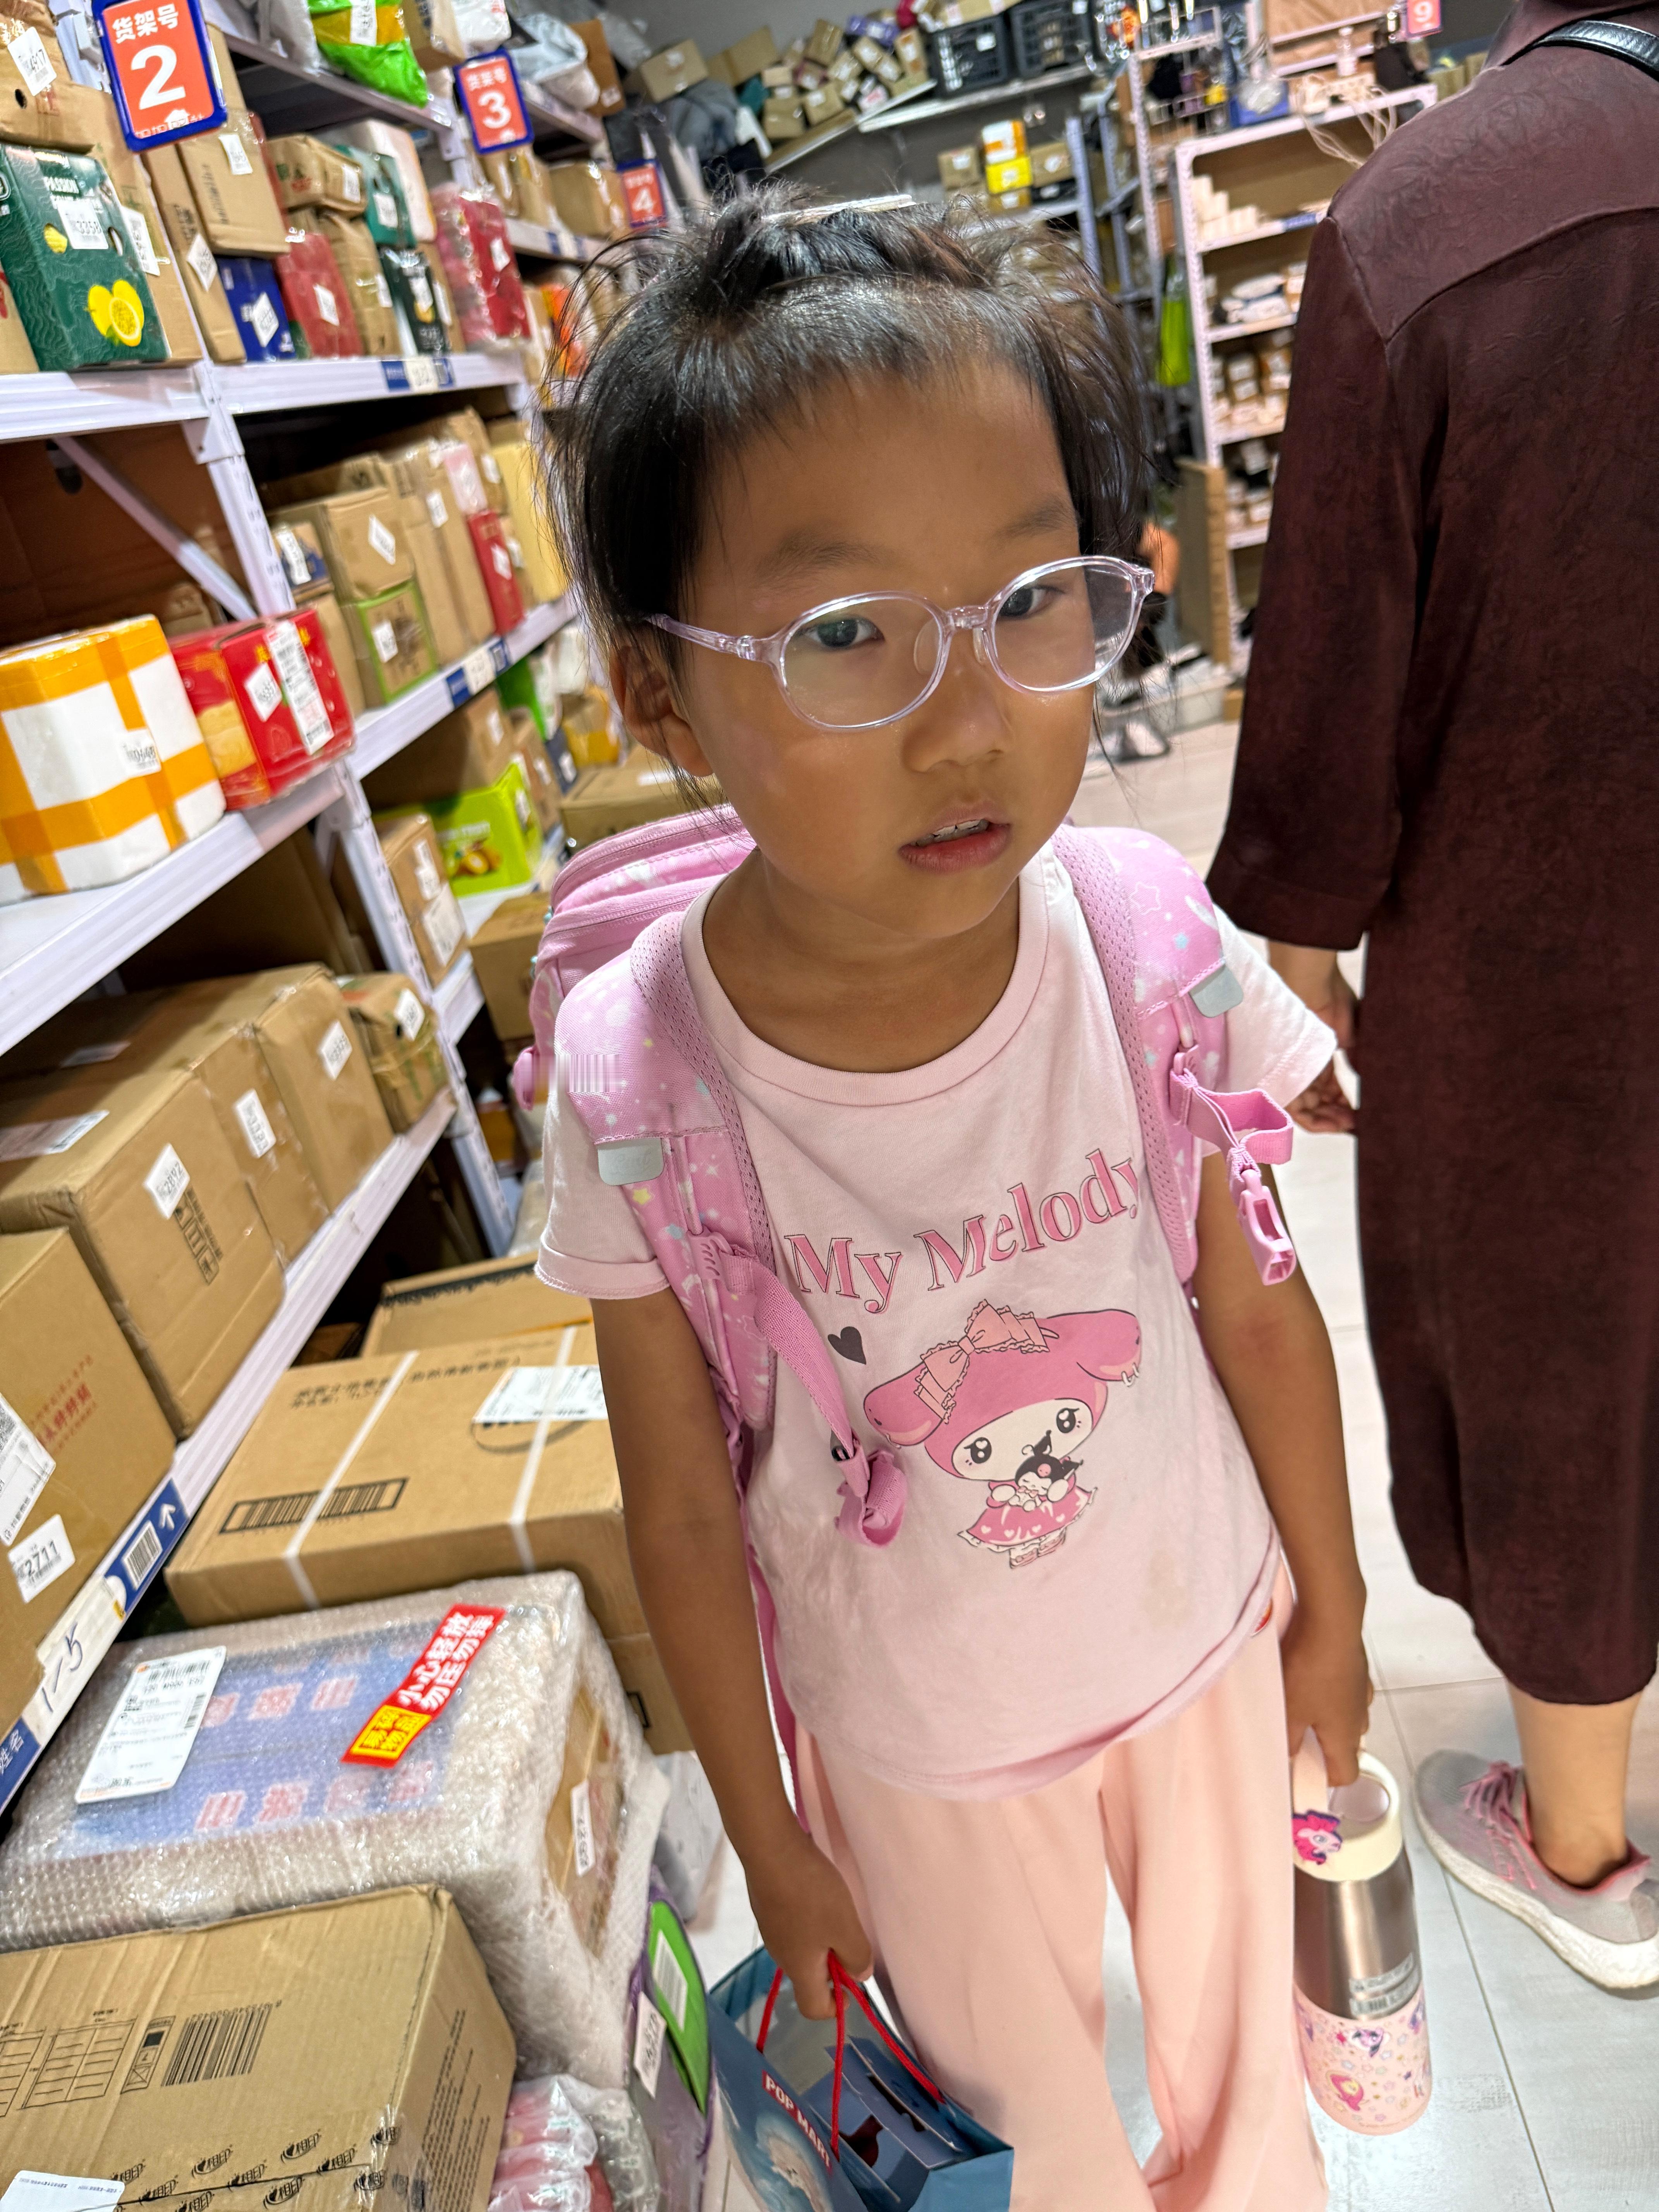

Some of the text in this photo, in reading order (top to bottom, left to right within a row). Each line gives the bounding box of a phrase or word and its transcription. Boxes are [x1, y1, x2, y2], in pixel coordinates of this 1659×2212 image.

[112, 3, 178, 44] 货架号
[1415, 2, 1432, 22] 9
[131, 45, 185, 110] 2
[478, 91, 512, 129] 3
[632, 188, 656, 213] 4
[784, 1148, 1139, 1314] My Melody
[25, 1540, 59, 1575] 2711
[398, 1612, 474, 1706] 小心轻放
[766, 2074, 830, 2167] POP MART
